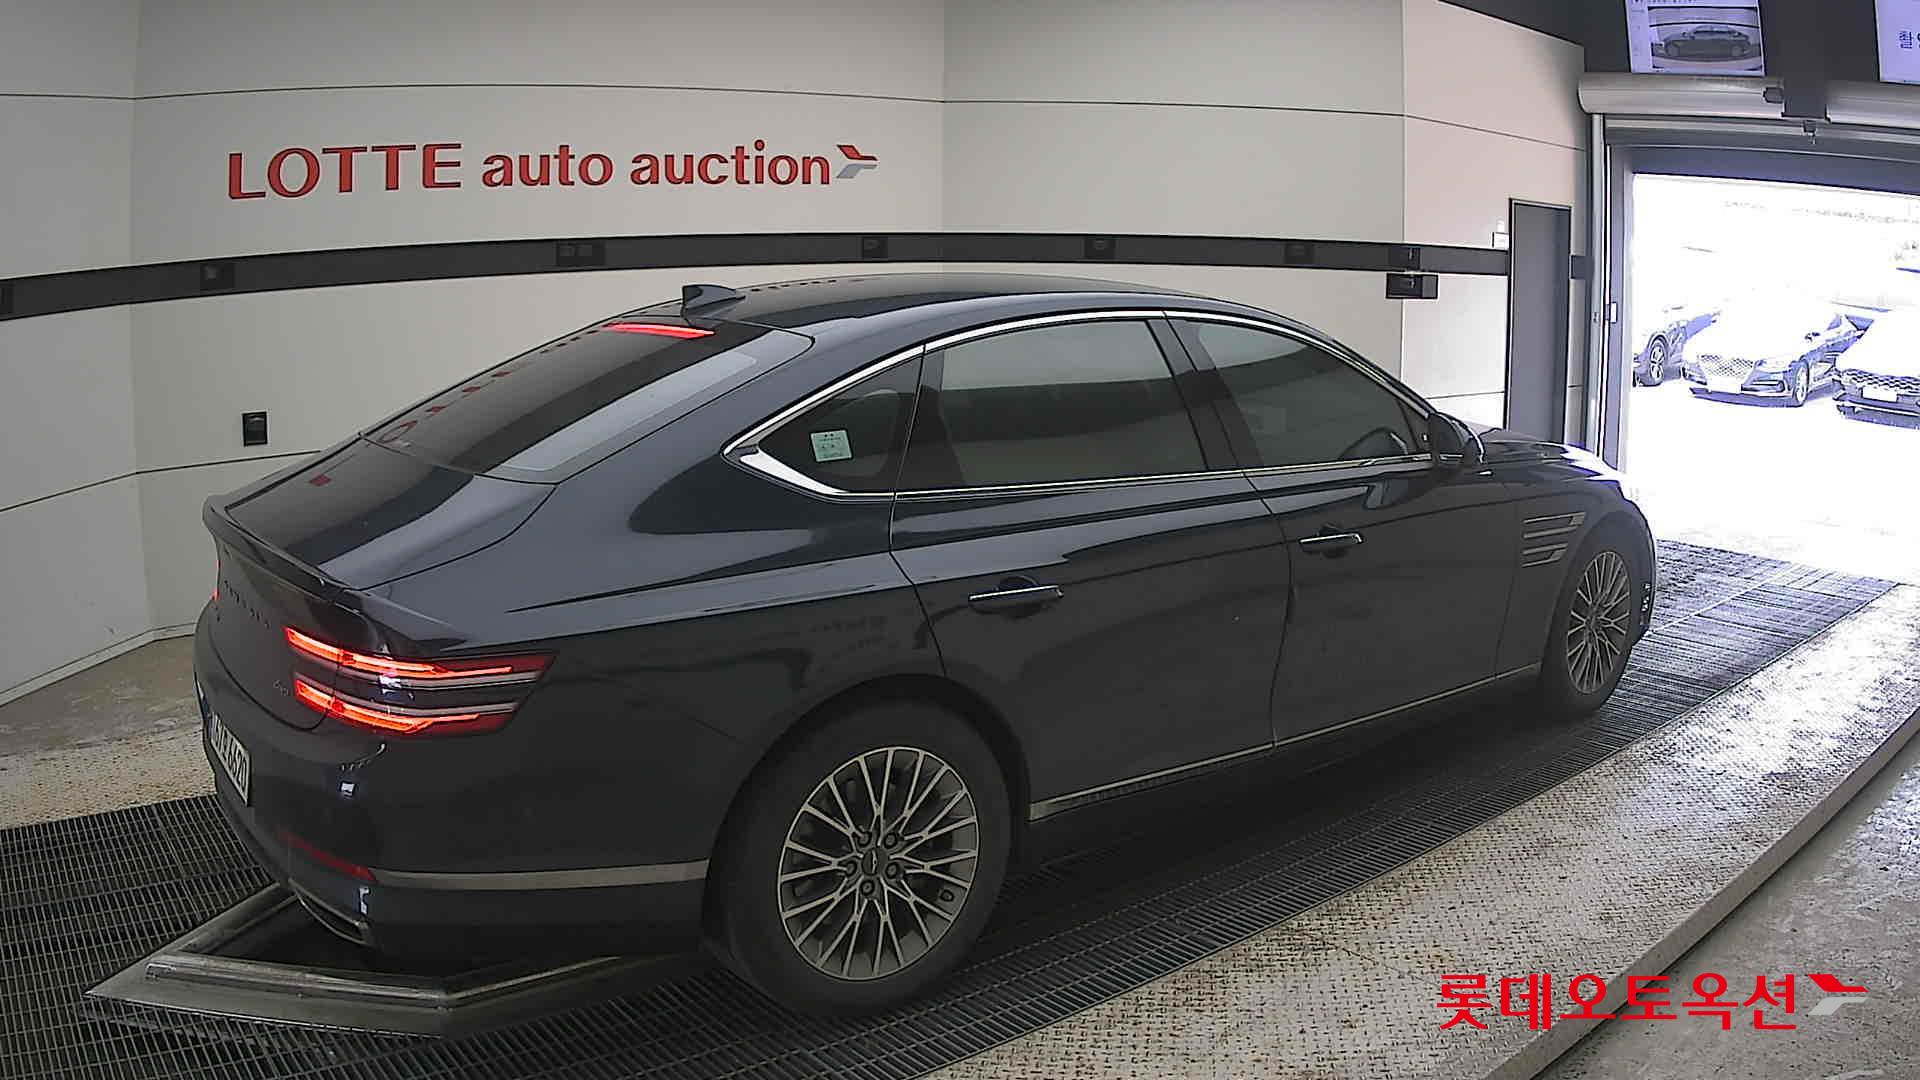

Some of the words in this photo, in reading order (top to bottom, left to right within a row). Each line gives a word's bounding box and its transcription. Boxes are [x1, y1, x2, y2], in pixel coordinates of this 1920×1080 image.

[229, 142, 461, 200] LOTTE
[482, 146, 615, 187] auto
[630, 139, 832, 185] auction
